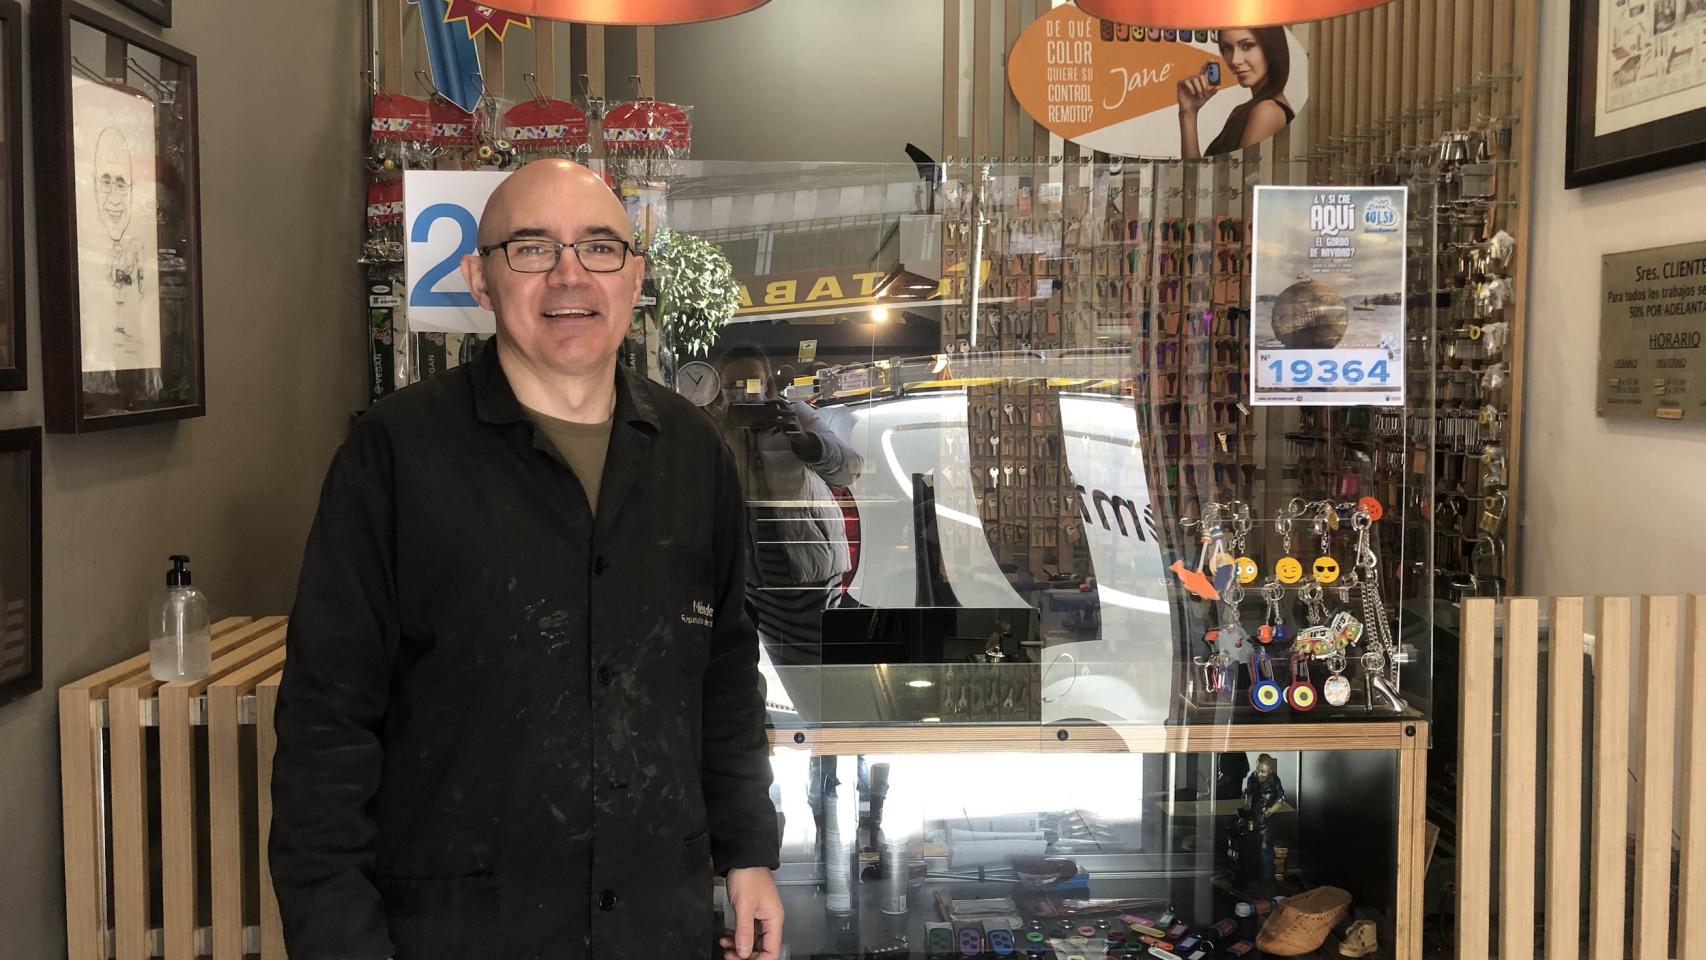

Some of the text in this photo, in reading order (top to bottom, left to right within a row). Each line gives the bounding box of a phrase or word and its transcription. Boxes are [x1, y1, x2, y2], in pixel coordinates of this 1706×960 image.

[1047, 17, 1093, 38] DE QUÉ
[1047, 41, 1093, 65] COLOR
[1048, 67, 1094, 82] QUIERE SU
[1048, 84, 1094, 103] CONTROL
[1103, 62, 1171, 110] Jane
[1049, 105, 1094, 123] REMOTO?
[1315, 236, 1350, 248] EL GORDO
[410, 203, 479, 307] 2
[1309, 247, 1356, 259] DE NAVIDAD?
[1635, 265, 1660, 282] Sres.
[1608, 291, 1623, 304] Para
[1625, 288, 1646, 302] todos
[1648, 287, 1660, 300] los
[1662, 284, 1696, 300] trabajos
[1646, 304, 1661, 318] POR
[1649, 331, 1701, 349] HORARIO
[375, 353, 383, 384] VEGAN
[428, 354, 436, 374] GAN
[1269, 360, 1390, 383] 19364
